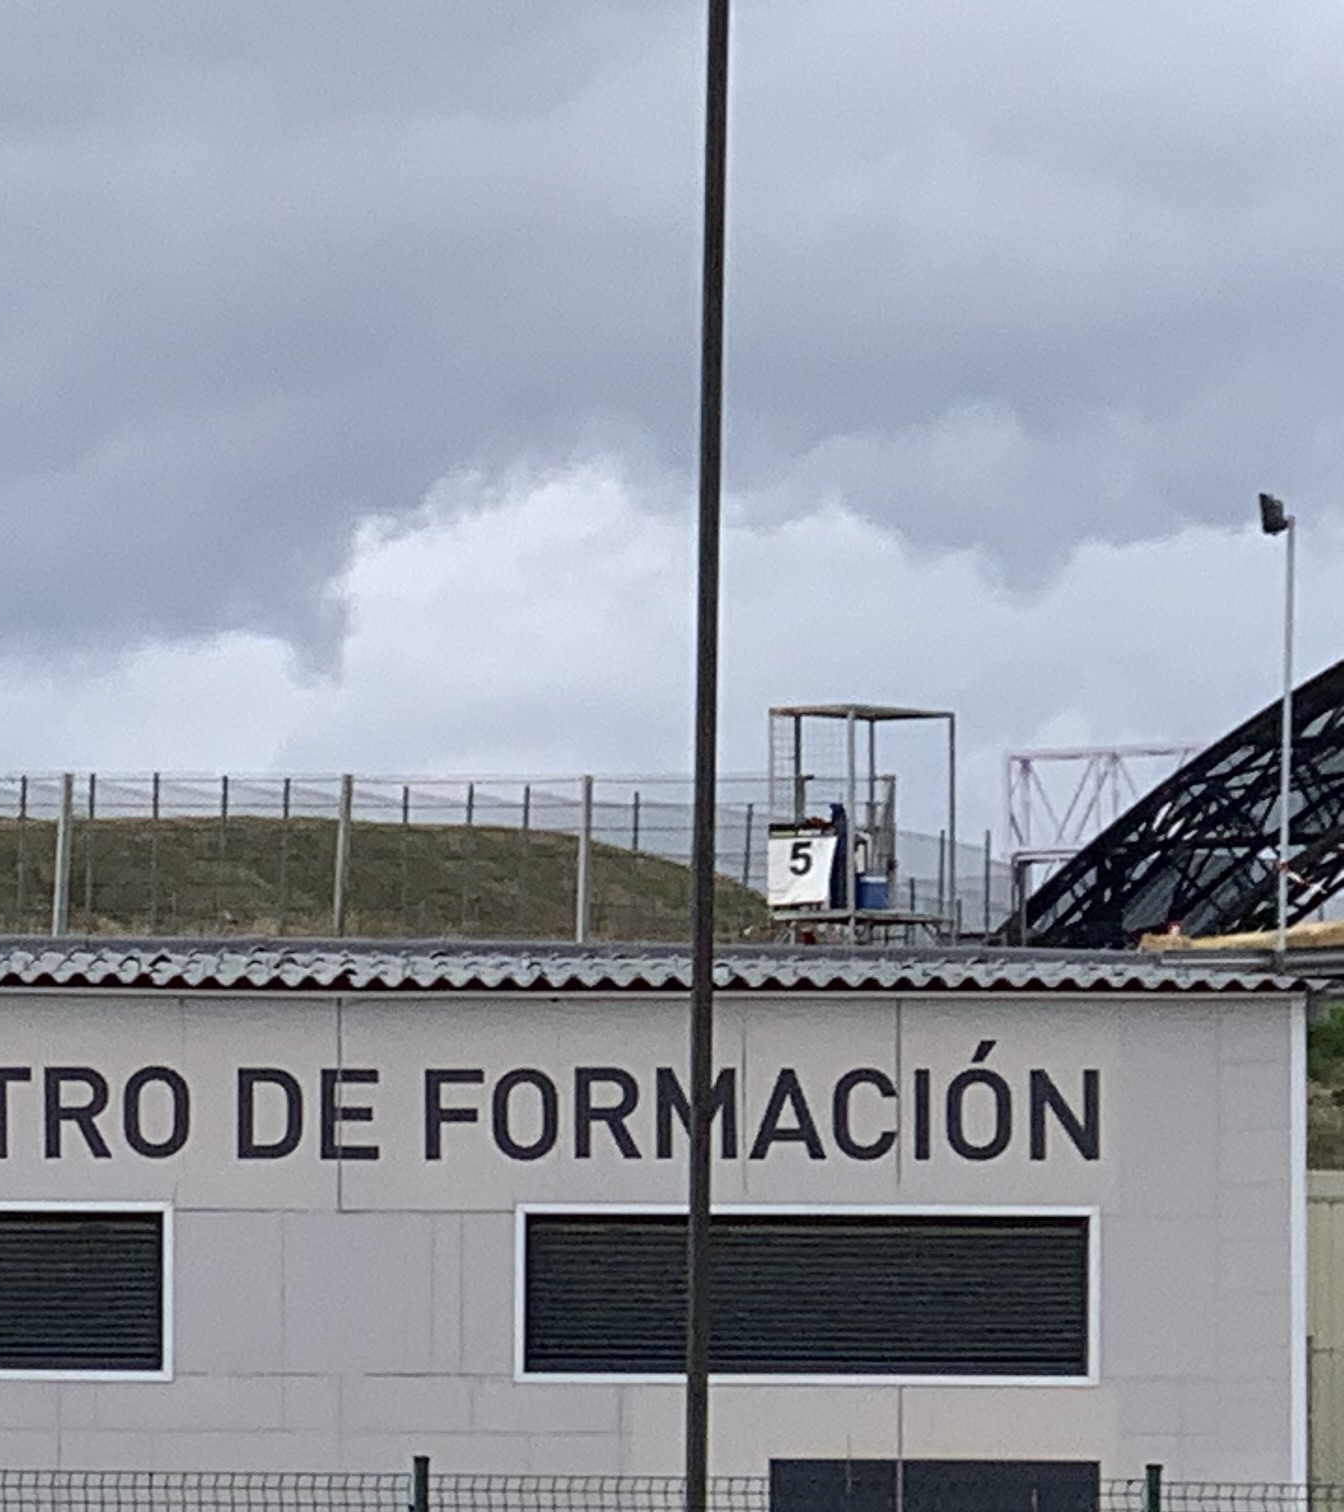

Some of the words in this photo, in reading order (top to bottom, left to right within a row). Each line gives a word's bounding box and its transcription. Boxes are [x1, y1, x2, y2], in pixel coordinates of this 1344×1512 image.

[789, 840, 813, 876] 5
[237, 1067, 380, 1161] DE
[424, 1039, 1100, 1162] FORMACIÓN
